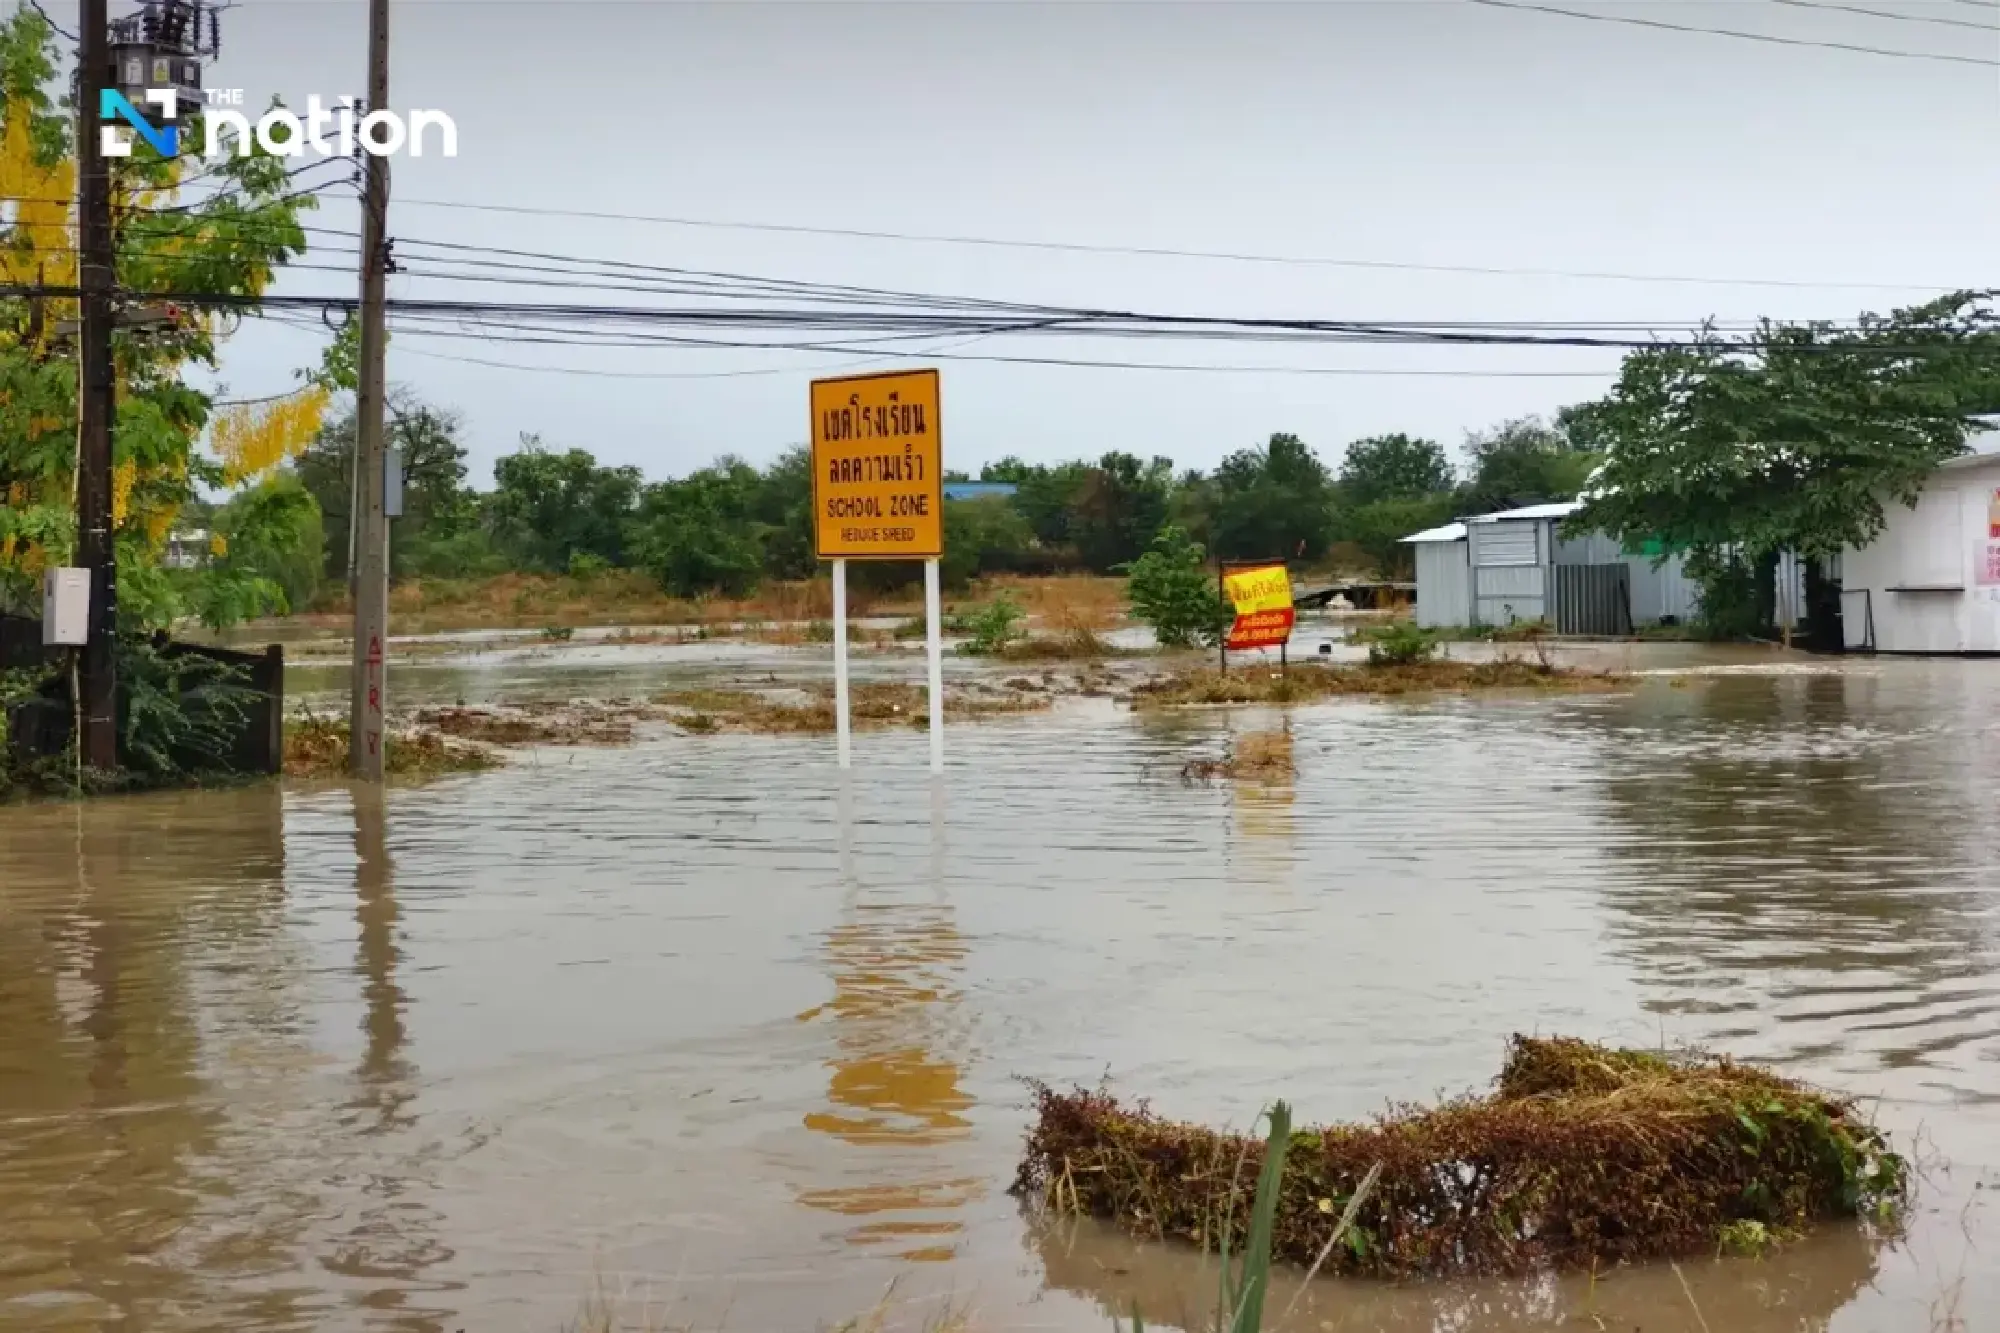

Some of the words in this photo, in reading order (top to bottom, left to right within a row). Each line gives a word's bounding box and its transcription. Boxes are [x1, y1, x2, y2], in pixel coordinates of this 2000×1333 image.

[823, 391, 927, 442] เขตโรงเรียน
[829, 443, 924, 484] ลดความเร็ว
[827, 496, 883, 518] SCHOOL
[890, 493, 929, 516] ZONE
[840, 527, 880, 542] REDUCE
[882, 527, 916, 541] SPEED
